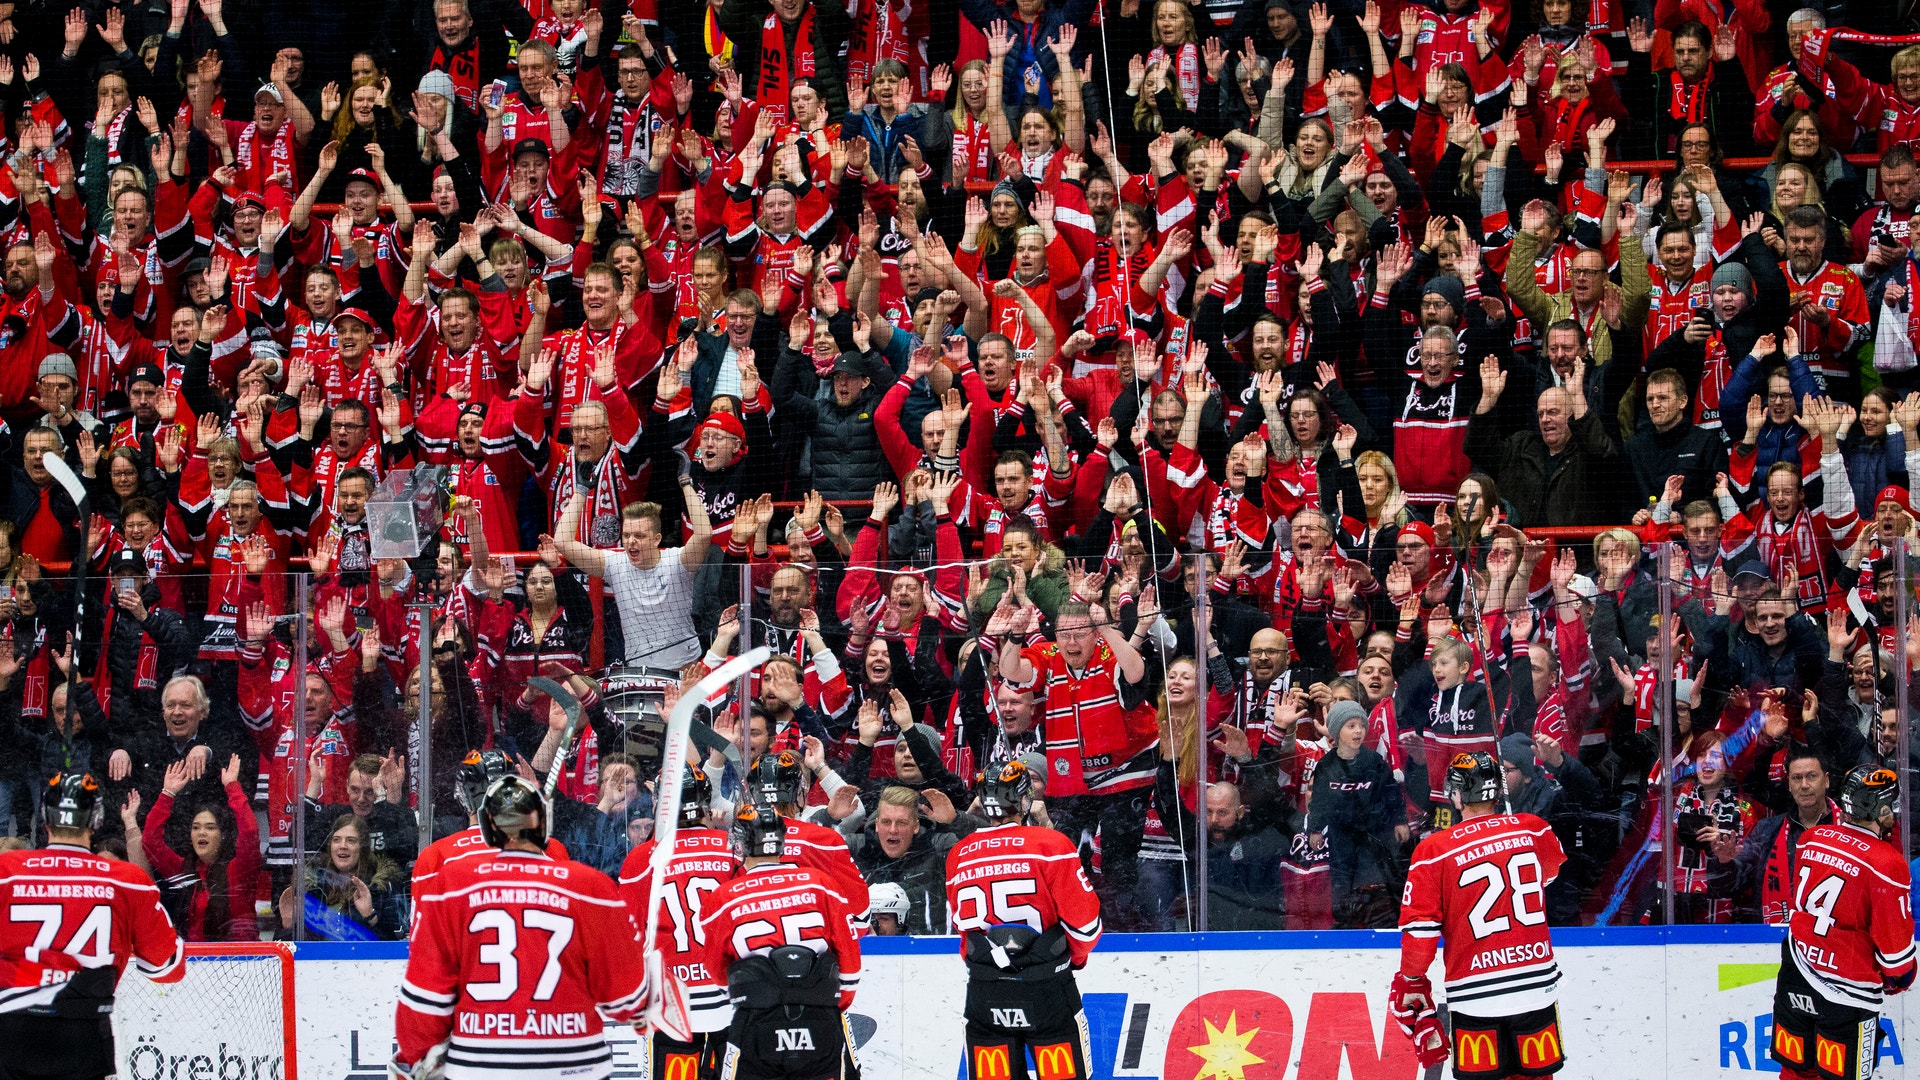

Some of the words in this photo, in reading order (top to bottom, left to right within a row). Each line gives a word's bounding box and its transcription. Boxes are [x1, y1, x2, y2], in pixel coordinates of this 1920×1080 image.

[763, 47, 781, 98] SHL
[222, 603, 239, 614] ÖRE
[765, 792, 778, 803] 33
[1329, 781, 1372, 791] CCM
[1481, 789, 1495, 801] 28
[60, 811, 74, 825] 74
[685, 810, 697, 819] 18
[986, 806, 1002, 816] 85
[762, 842, 777, 854] 65
[1454, 836, 1534, 866] MALMBERGS
[663, 861, 731, 877] LMBERGS
[954, 862, 1031, 886] MALMBERGS
[12, 884, 116, 900] MALMBERGS
[468, 889, 570, 910] MALMBERGS
[1458, 851, 1546, 941] 28
[1796, 864, 1847, 937] 14
[731, 892, 817, 921] MALMBERGS
[952, 878, 1044, 935] 85
[10, 904, 116, 969] 74
[466, 908, 575, 1002] 37
[1469, 940, 1550, 971] ARNESSON
[1787, 992, 1819, 1016] NA
[459, 1009, 588, 1036] KILPELÄINEN
[990, 1007, 1031, 1028] NA
[775, 1028, 816, 1052] NA
[1861, 1017, 1876, 1080] Structor
